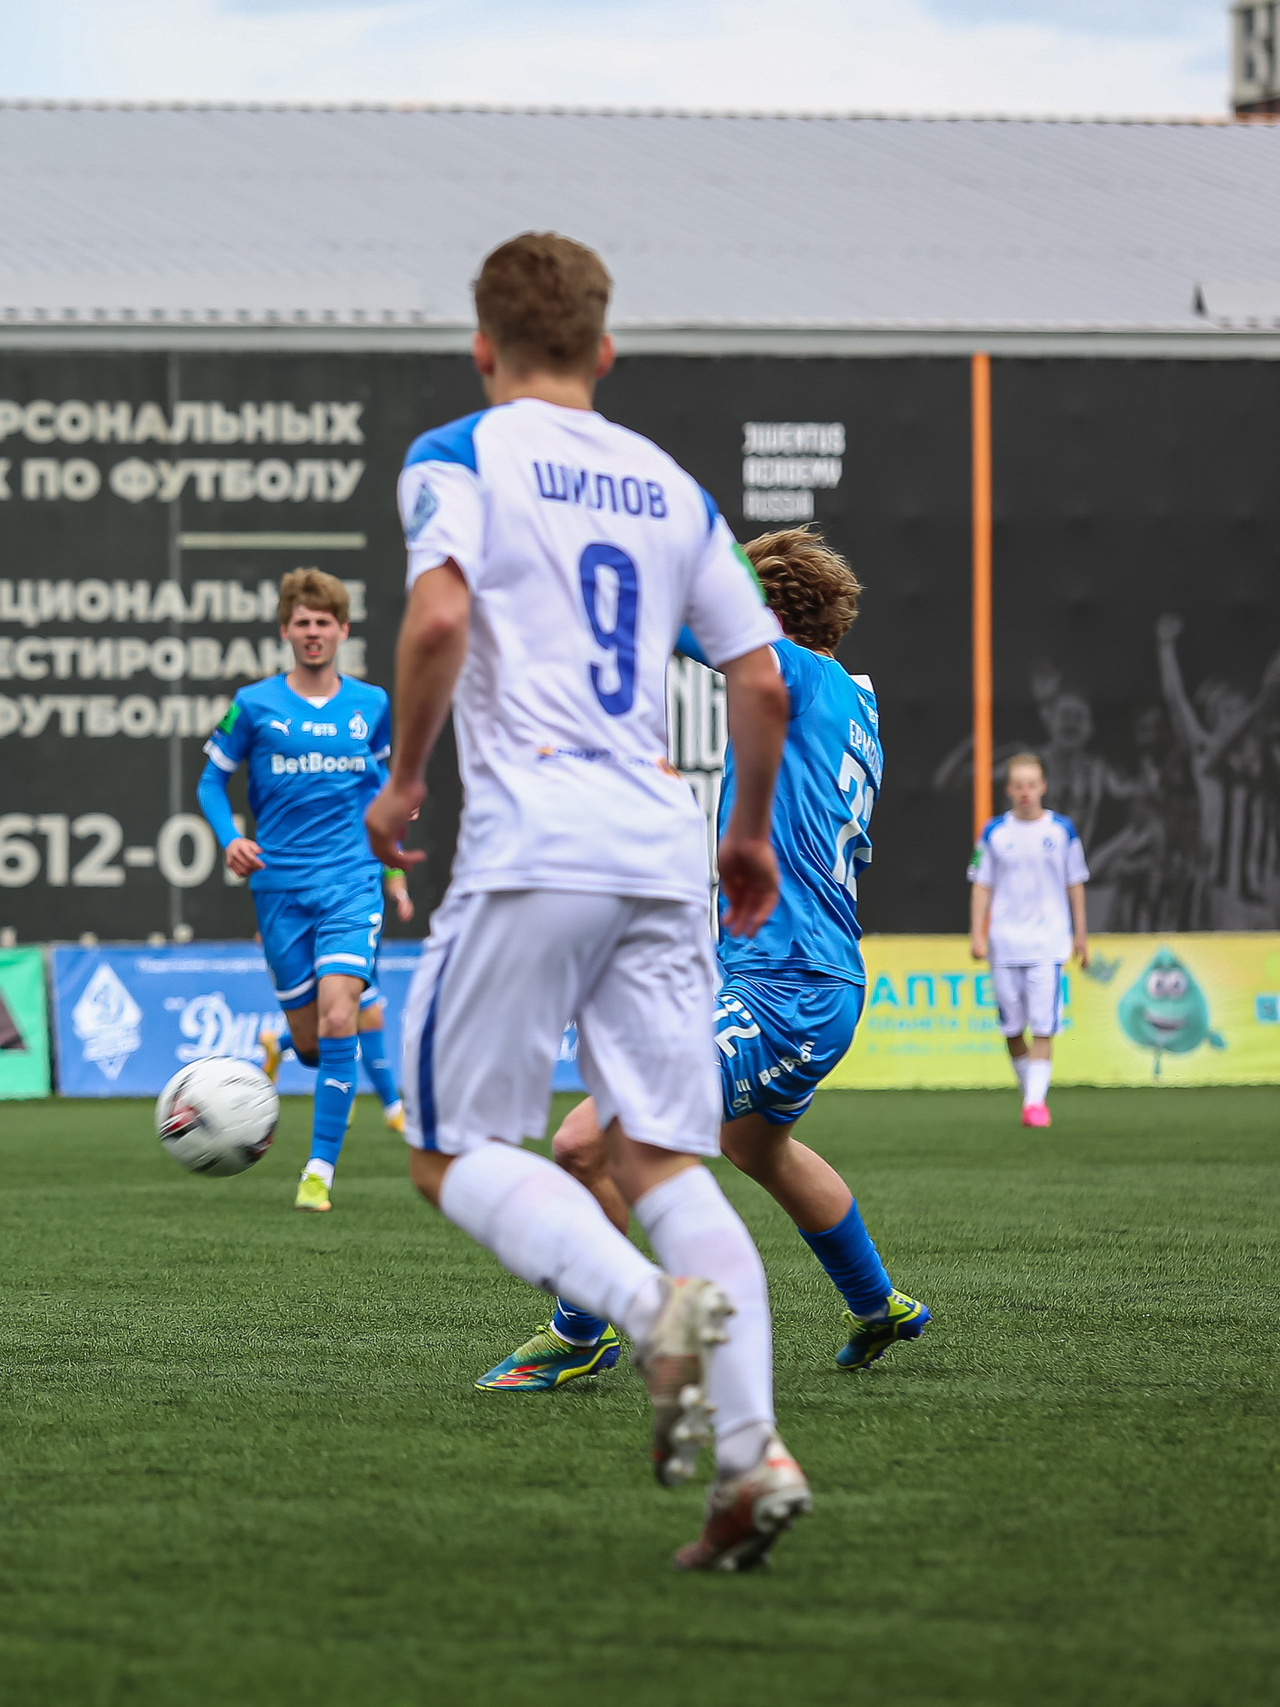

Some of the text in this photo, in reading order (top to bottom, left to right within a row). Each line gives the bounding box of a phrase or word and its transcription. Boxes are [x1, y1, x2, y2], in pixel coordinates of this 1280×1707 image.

[21, 457, 102, 501] ПО
[109, 456, 366, 502] ФУТБОЛУ
[533, 462, 668, 519] ШИЛОВ
[580, 543, 638, 715] 9
[271, 752, 366, 775] BetBoom
